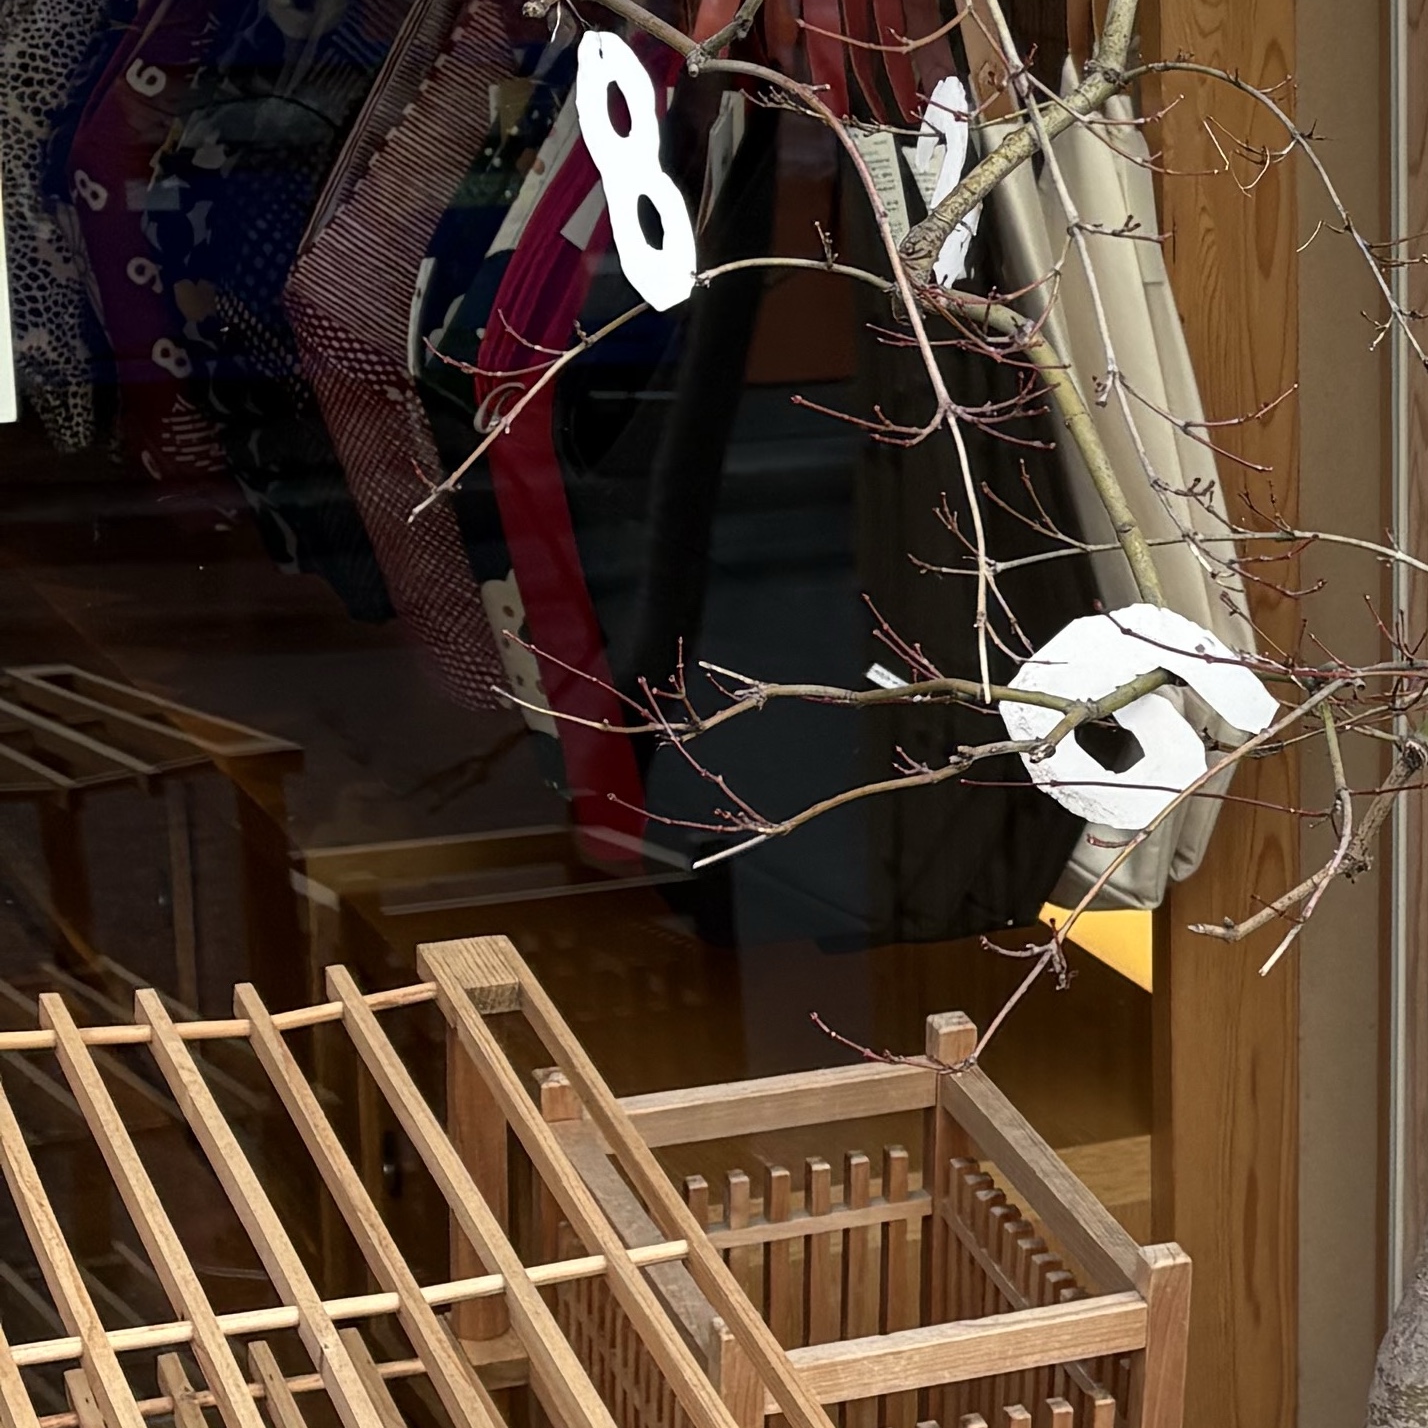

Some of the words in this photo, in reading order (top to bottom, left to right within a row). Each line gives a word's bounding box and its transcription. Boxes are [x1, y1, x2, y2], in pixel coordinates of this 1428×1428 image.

[126, 58, 166, 98] 6
[575, 31, 698, 312] 8
[1000, 602, 1278, 829] 6
